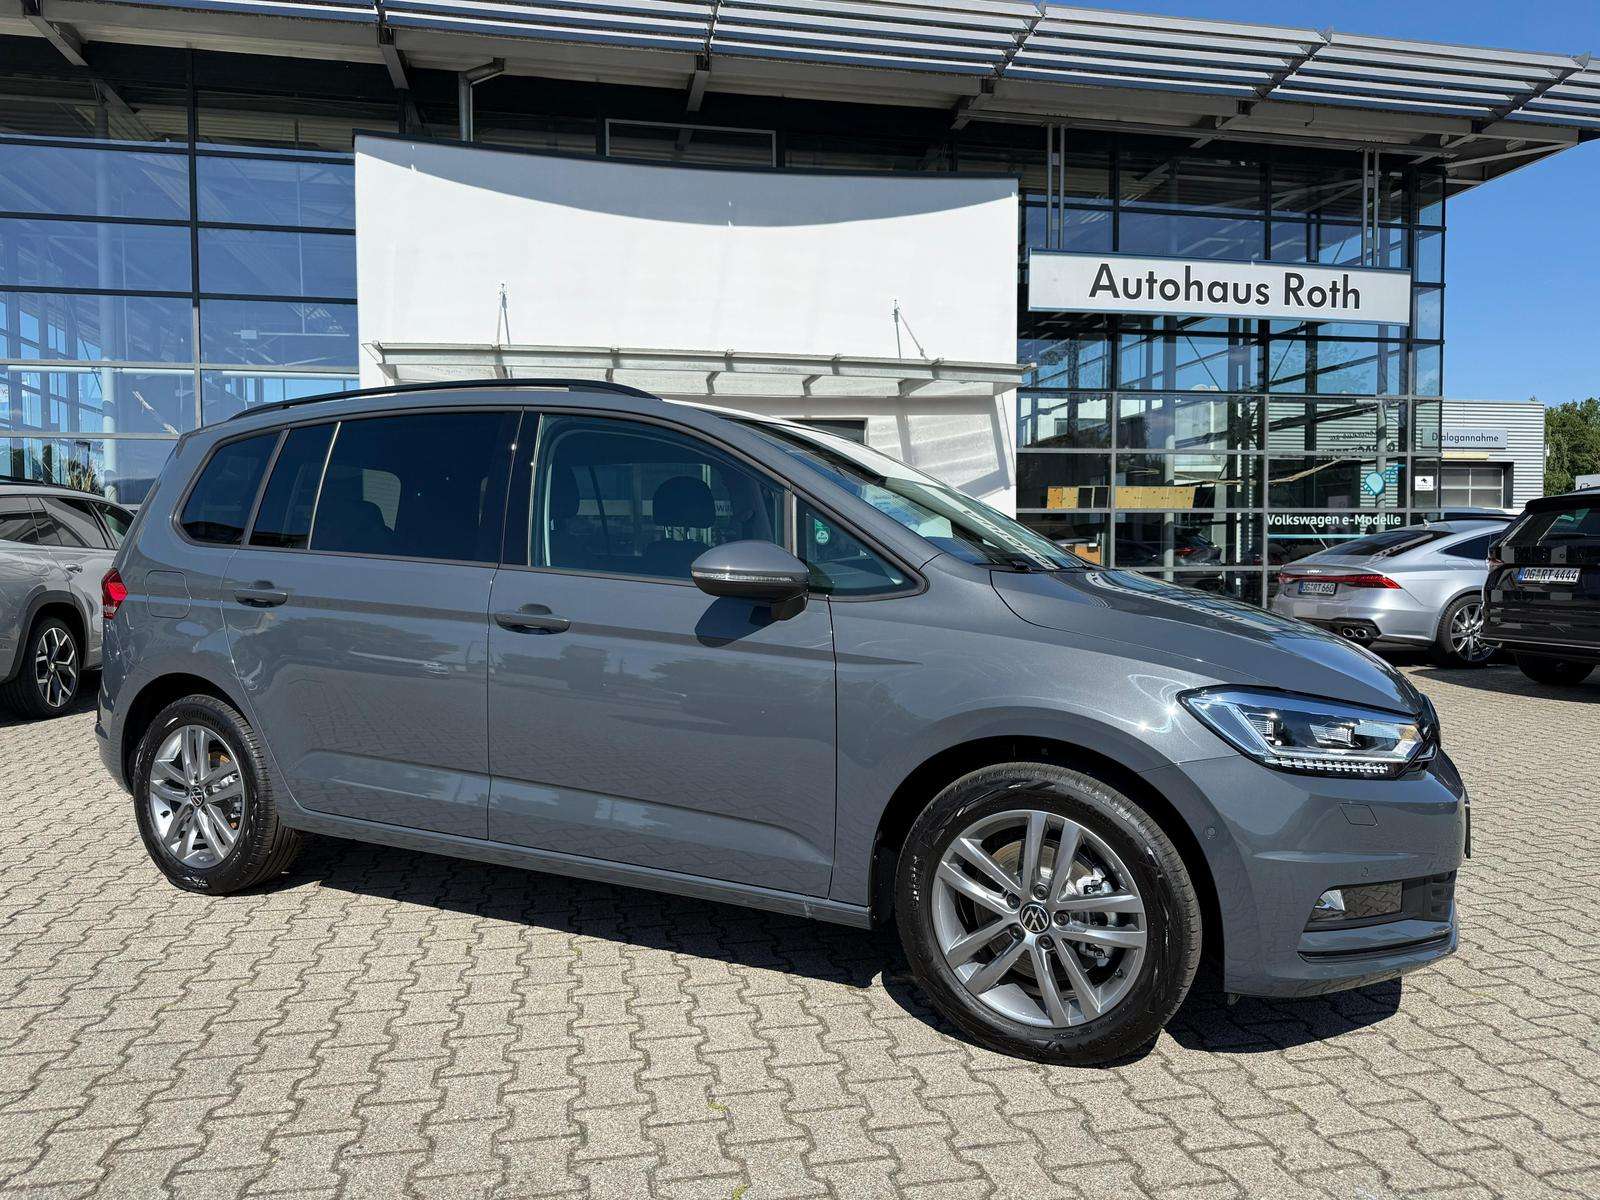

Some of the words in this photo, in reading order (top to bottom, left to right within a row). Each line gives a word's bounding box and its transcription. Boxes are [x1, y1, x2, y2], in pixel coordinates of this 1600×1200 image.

[1088, 263, 1270, 305] Autohaus
[1283, 271, 1360, 310] Roth
[1432, 431, 1499, 443] Dalogannahme
[1267, 513, 1339, 528] Volkswagen
[1341, 513, 1401, 526] e-Modelle
[1541, 569, 1554, 580] RT
[1554, 569, 1578, 581] 4444
